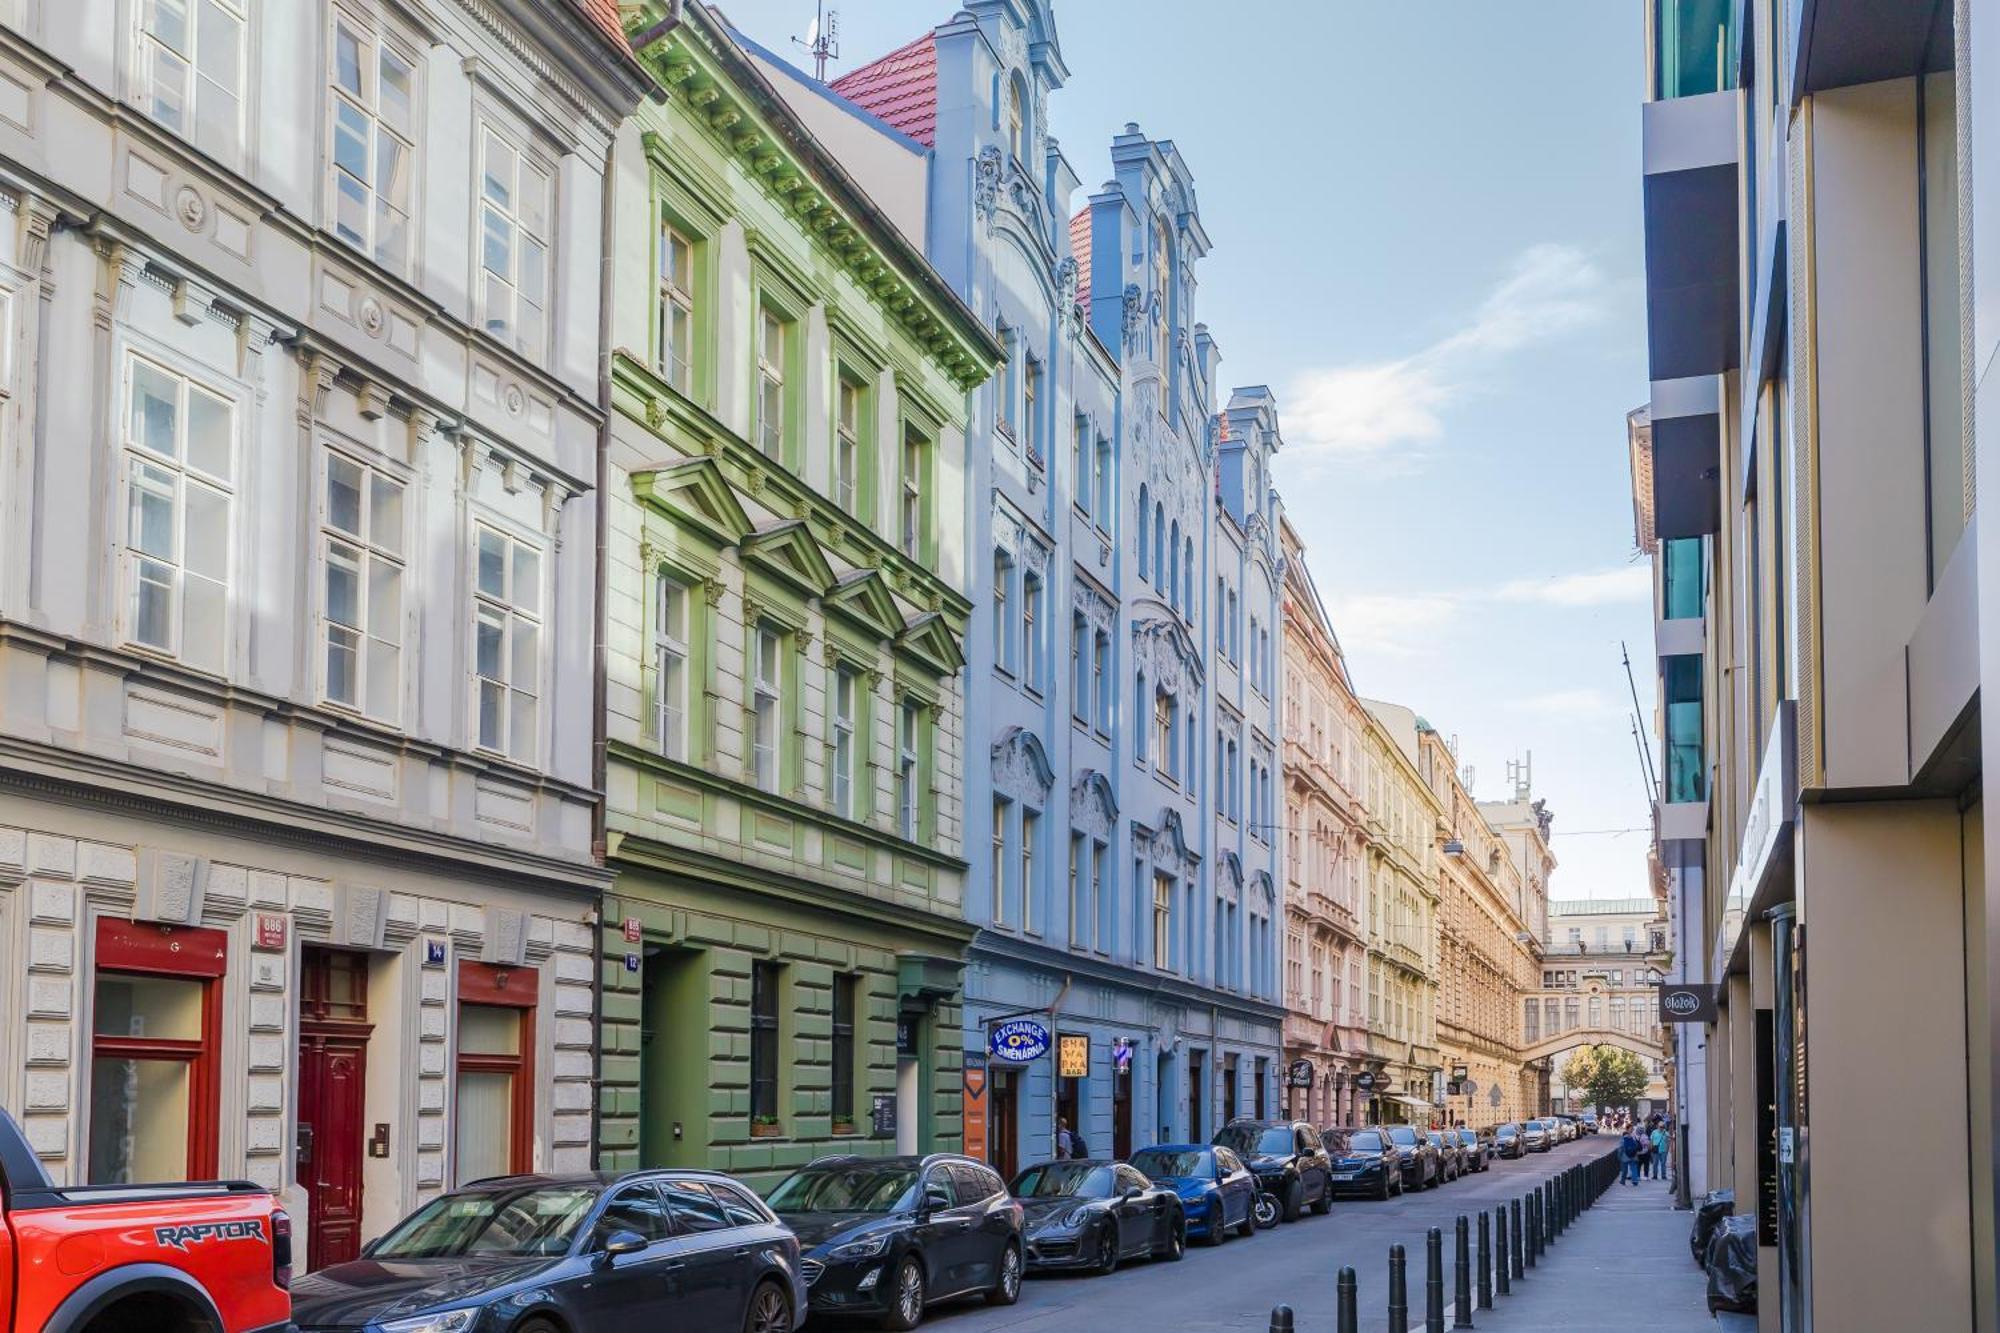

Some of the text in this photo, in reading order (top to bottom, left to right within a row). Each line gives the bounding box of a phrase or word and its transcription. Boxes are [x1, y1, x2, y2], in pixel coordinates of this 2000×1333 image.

[994, 1023, 1044, 1043] EXCHANGE
[1008, 1034, 1034, 1047] 0%
[996, 1042, 1046, 1060] SMĚNÁRNA
[153, 1219, 269, 1254] RAPTOR
